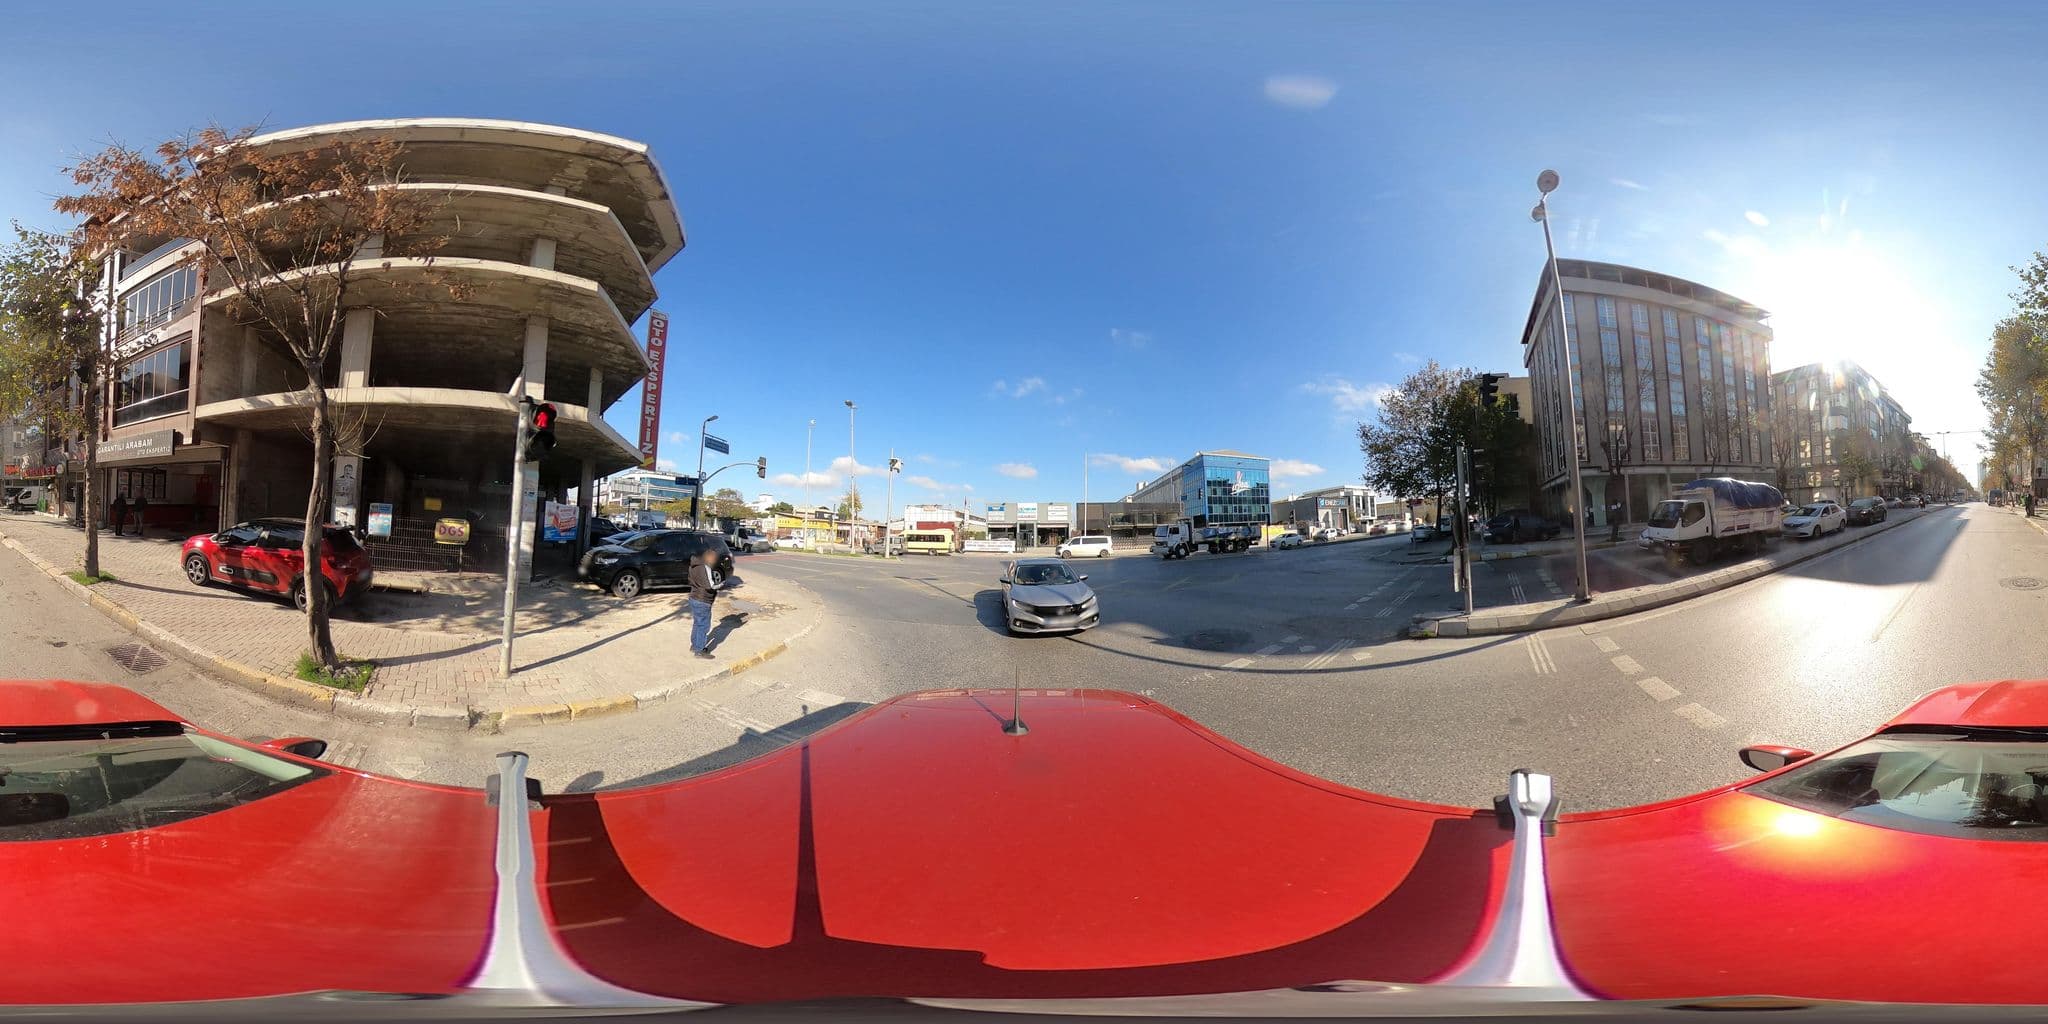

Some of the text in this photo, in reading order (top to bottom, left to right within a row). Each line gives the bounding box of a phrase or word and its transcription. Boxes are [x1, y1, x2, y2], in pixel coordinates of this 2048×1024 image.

[650, 319, 665, 347] OTO
[125, 438, 153, 450] ARABAM
[439, 525, 465, 537] DGS
